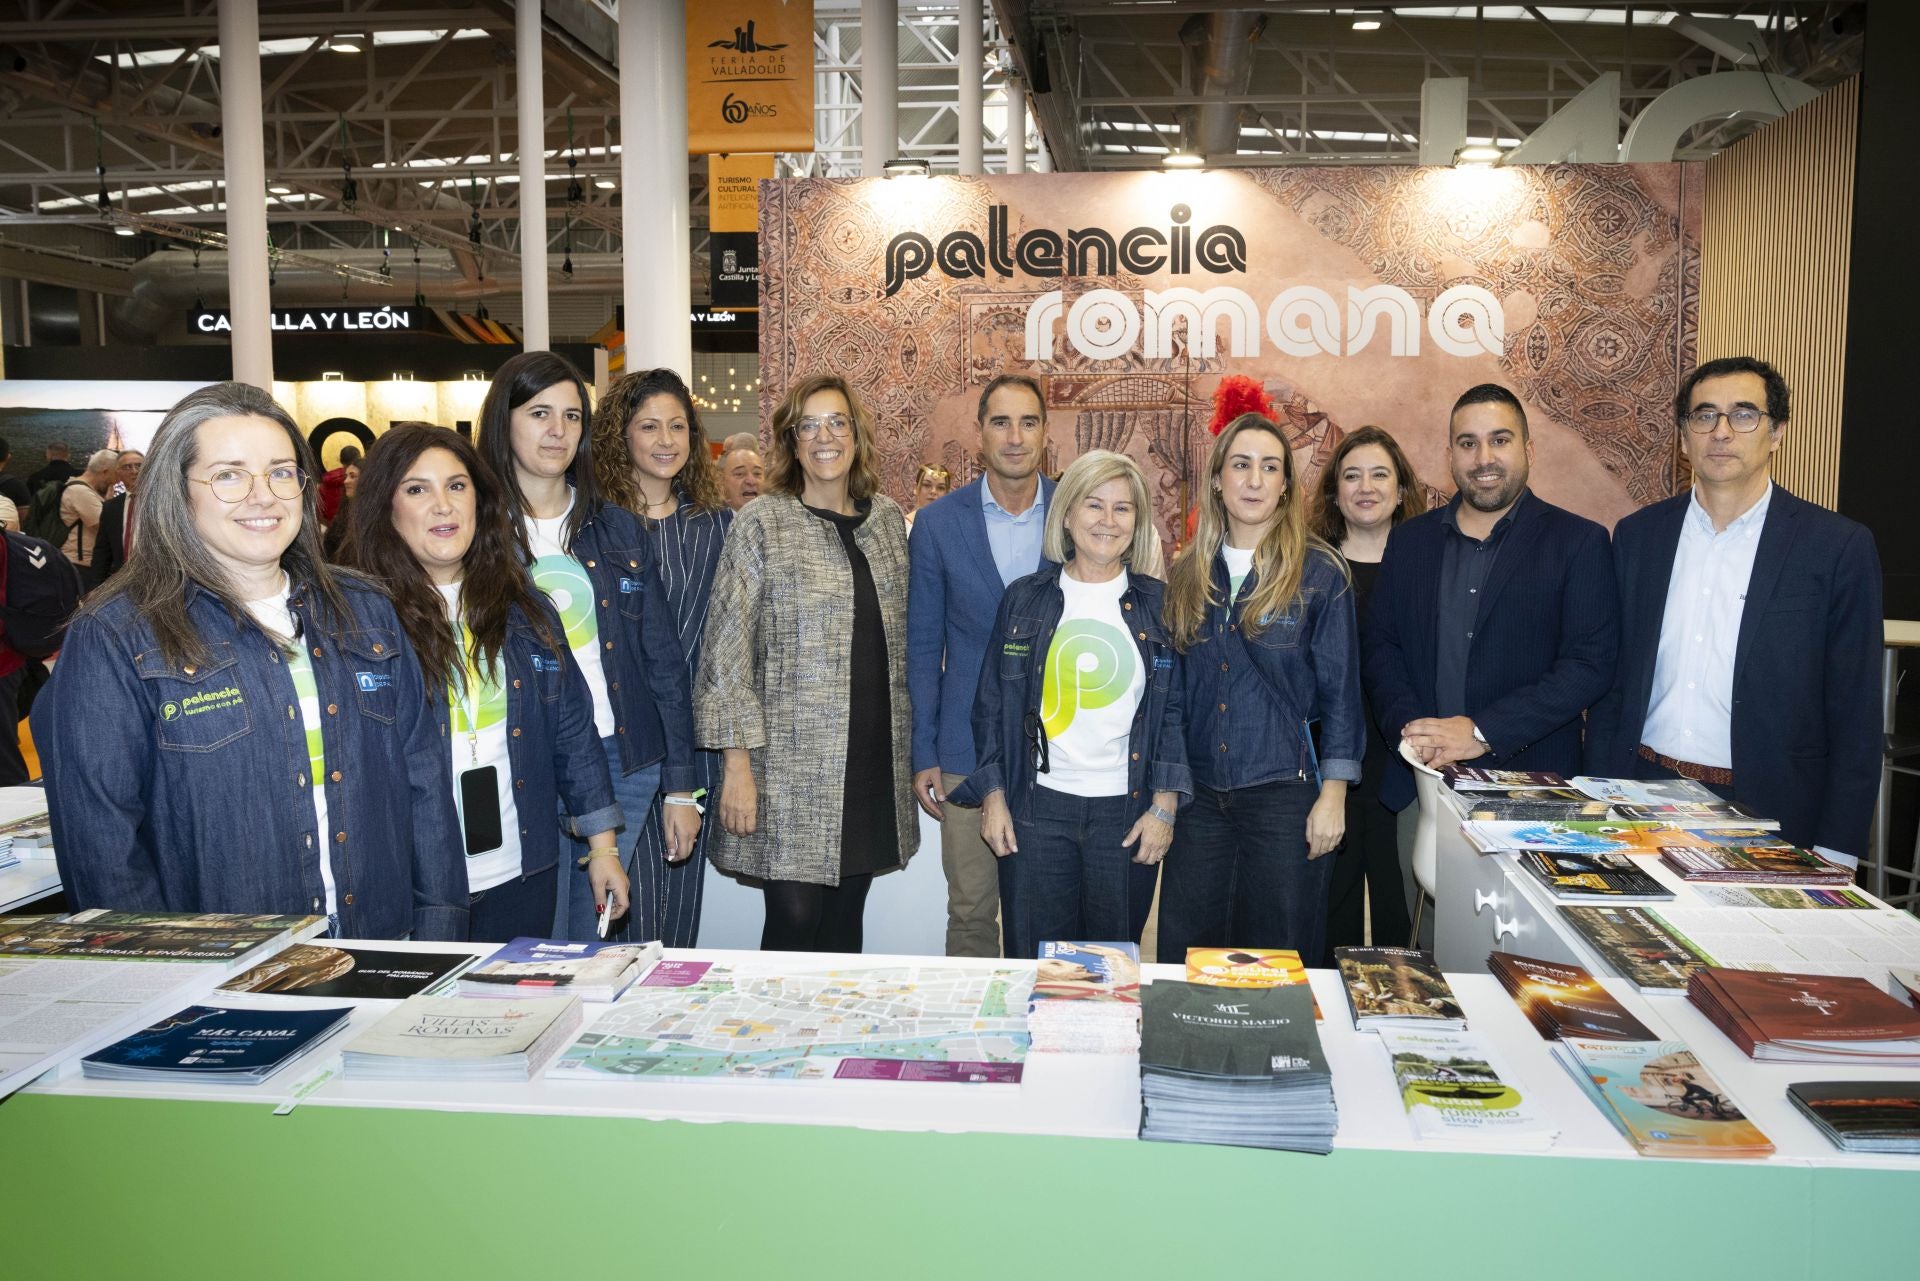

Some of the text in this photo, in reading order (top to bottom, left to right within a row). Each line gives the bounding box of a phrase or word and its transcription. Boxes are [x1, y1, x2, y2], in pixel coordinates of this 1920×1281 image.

[711, 54, 786, 65] FERIA DE
[711, 64, 786, 76] VALLADOLID
[747, 103, 777, 117] AÑOS
[717, 185, 757, 193] CULTURAL
[885, 203, 1247, 298] palencia
[718, 273, 745, 281] Castilla
[197, 305, 410, 332] CALLA Y LEÓN
[697, 313, 706, 322] Y
[706, 311, 736, 322] LEÓN
[1025, 285, 1504, 360] romana
[182, 687, 241, 709] palencia
[421, 1016, 491, 1027] VILLAS
[1171, 1012, 1239, 1026] VICTORIO
[1240, 1018, 1291, 1027] MACHO
[194, 1028, 299, 1038] MÁS CANAL
[407, 1025, 515, 1035] ROMANAS
[1427, 1095, 1484, 1107] Rutas
[1438, 1109, 1521, 1119] TURISMO
